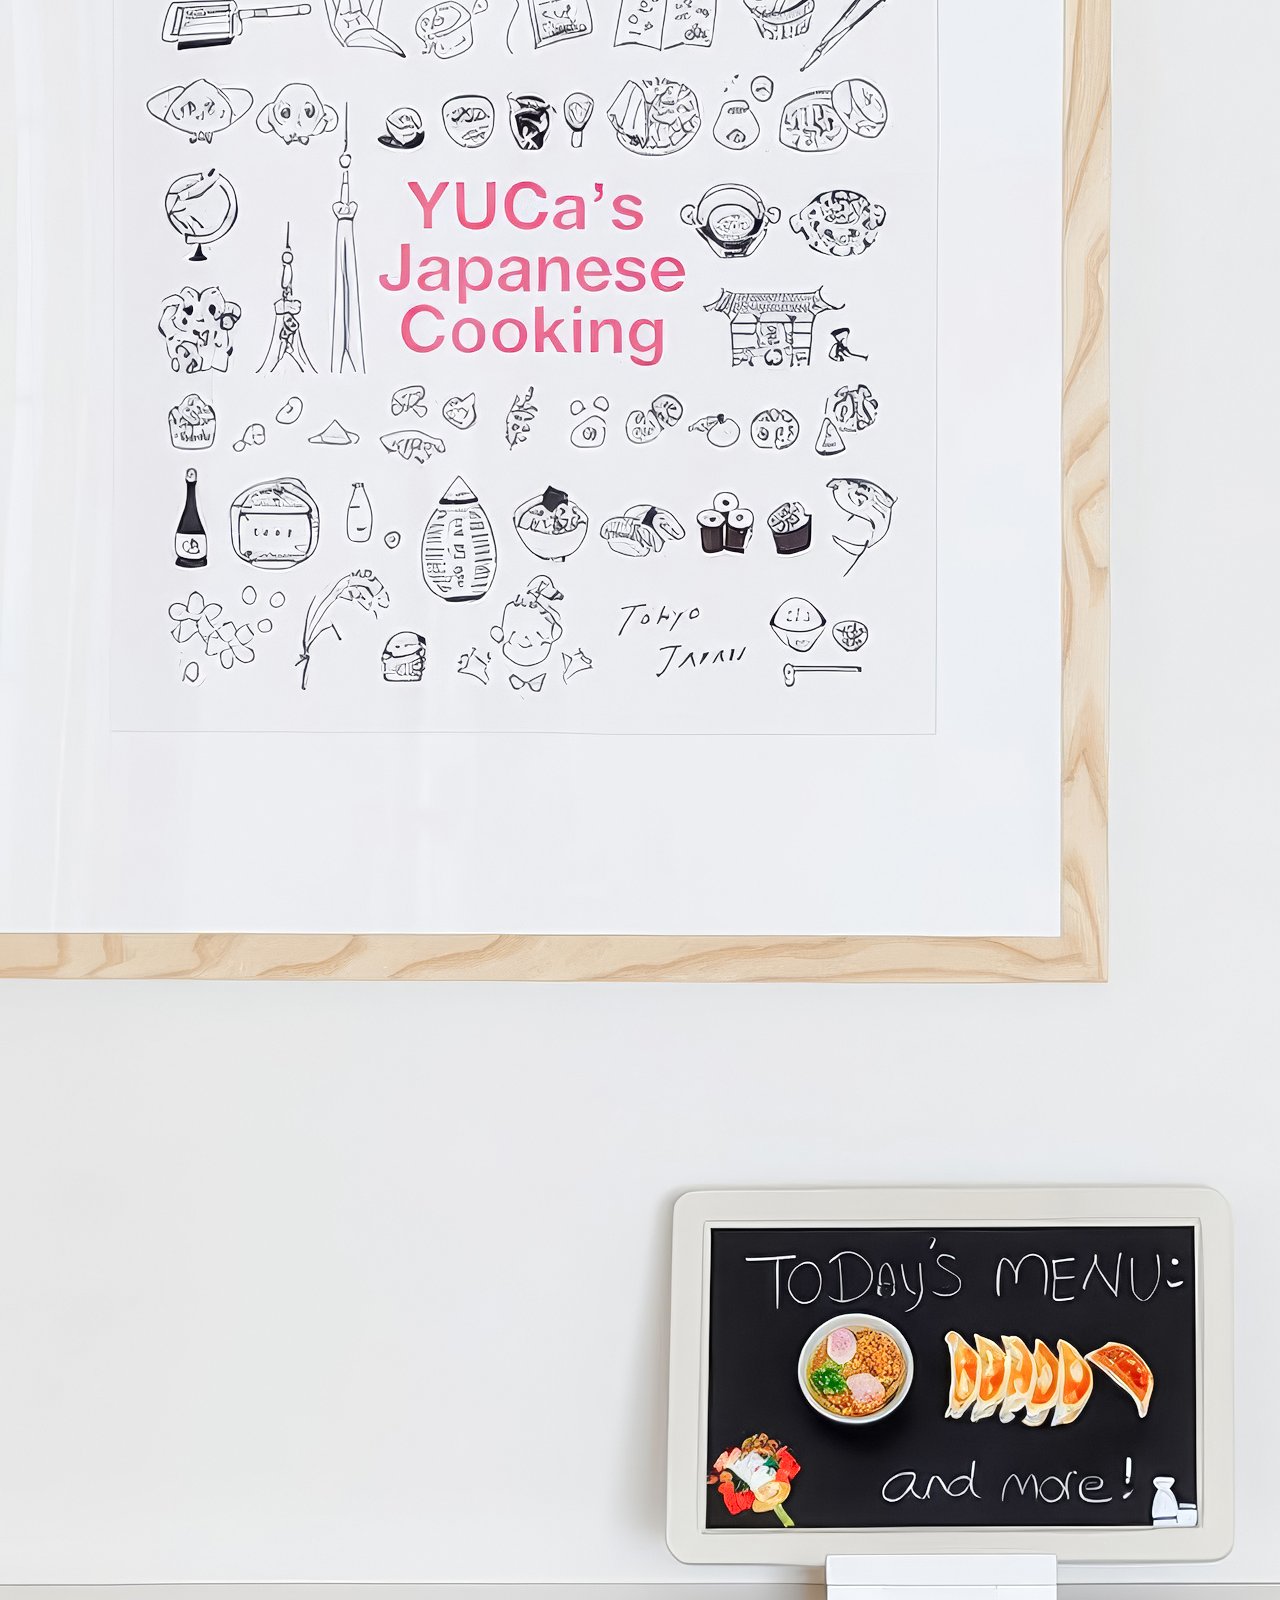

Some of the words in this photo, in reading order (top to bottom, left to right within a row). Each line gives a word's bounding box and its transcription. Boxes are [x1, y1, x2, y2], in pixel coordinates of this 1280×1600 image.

[407, 181, 644, 230] YUCa’s
[379, 244, 686, 303] Japanese
[401, 305, 664, 366] Cooking
[881, 1460, 982, 1503] and
